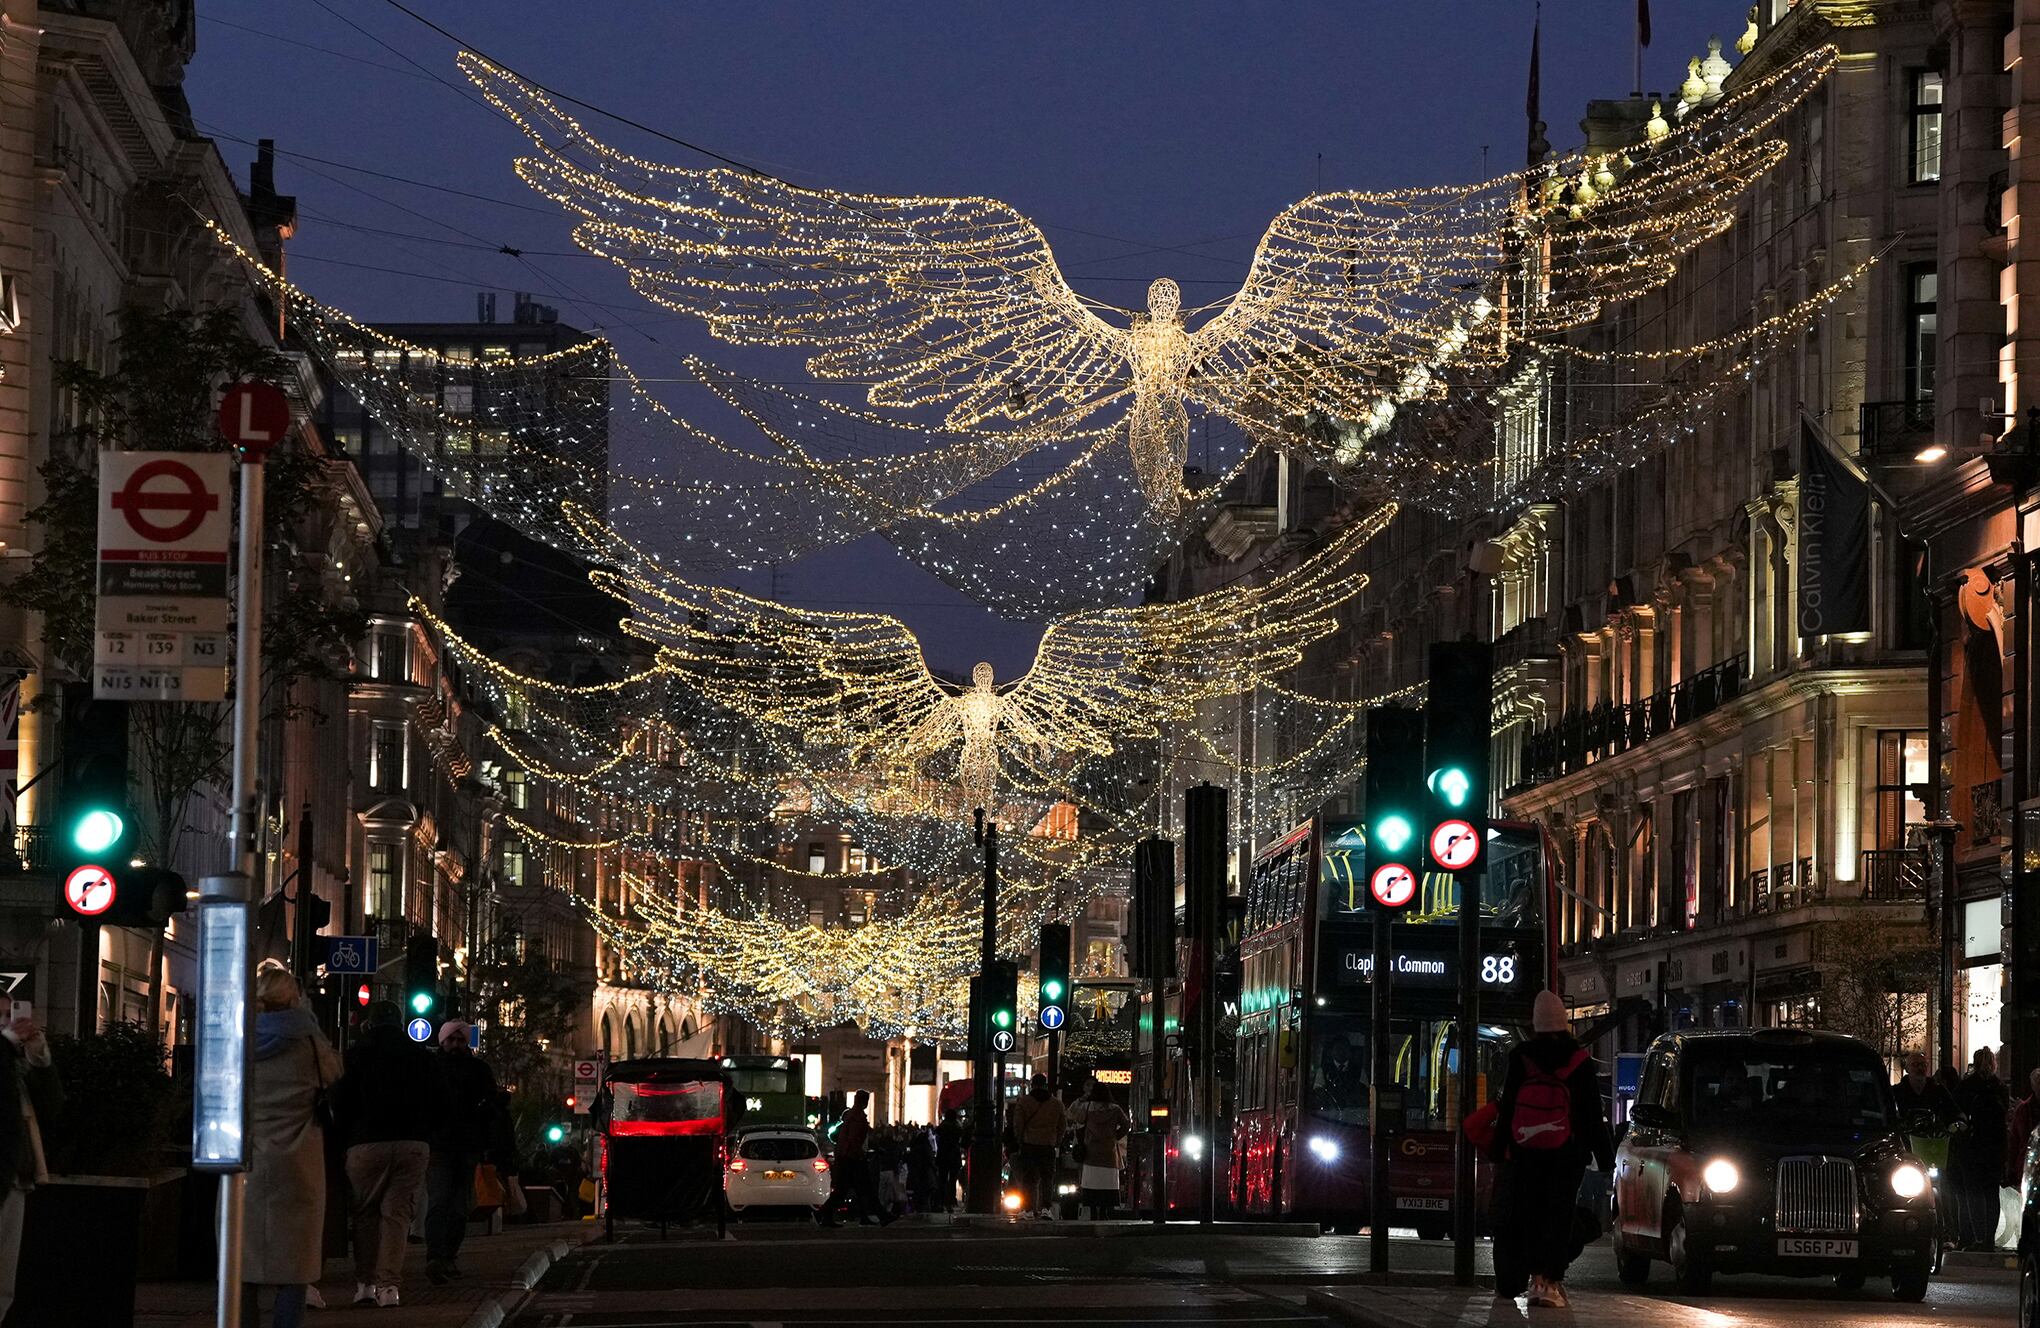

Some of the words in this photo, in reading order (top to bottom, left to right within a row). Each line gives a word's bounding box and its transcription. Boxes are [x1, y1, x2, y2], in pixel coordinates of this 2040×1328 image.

[1802, 474, 1826, 537] Klein
[138, 551, 159, 560] BUS
[161, 551, 189, 561] STOP
[1801, 543, 1822, 632] Calvin
[126, 613, 159, 623] Baker
[160, 613, 198, 624] Street
[109, 641, 125, 654] 12
[148, 641, 174, 654] 139
[193, 643, 216, 656] N3
[101, 676, 132, 689] N15
[139, 676, 180, 689] N113
[1398, 954, 1445, 974] Common
[1481, 956, 1514, 983] 88
[1402, 1198, 1423, 1208] YX13
[1425, 1199, 1443, 1209] BKE
[1784, 1240, 1821, 1254] LS66
[1825, 1241, 1852, 1255] PJV
